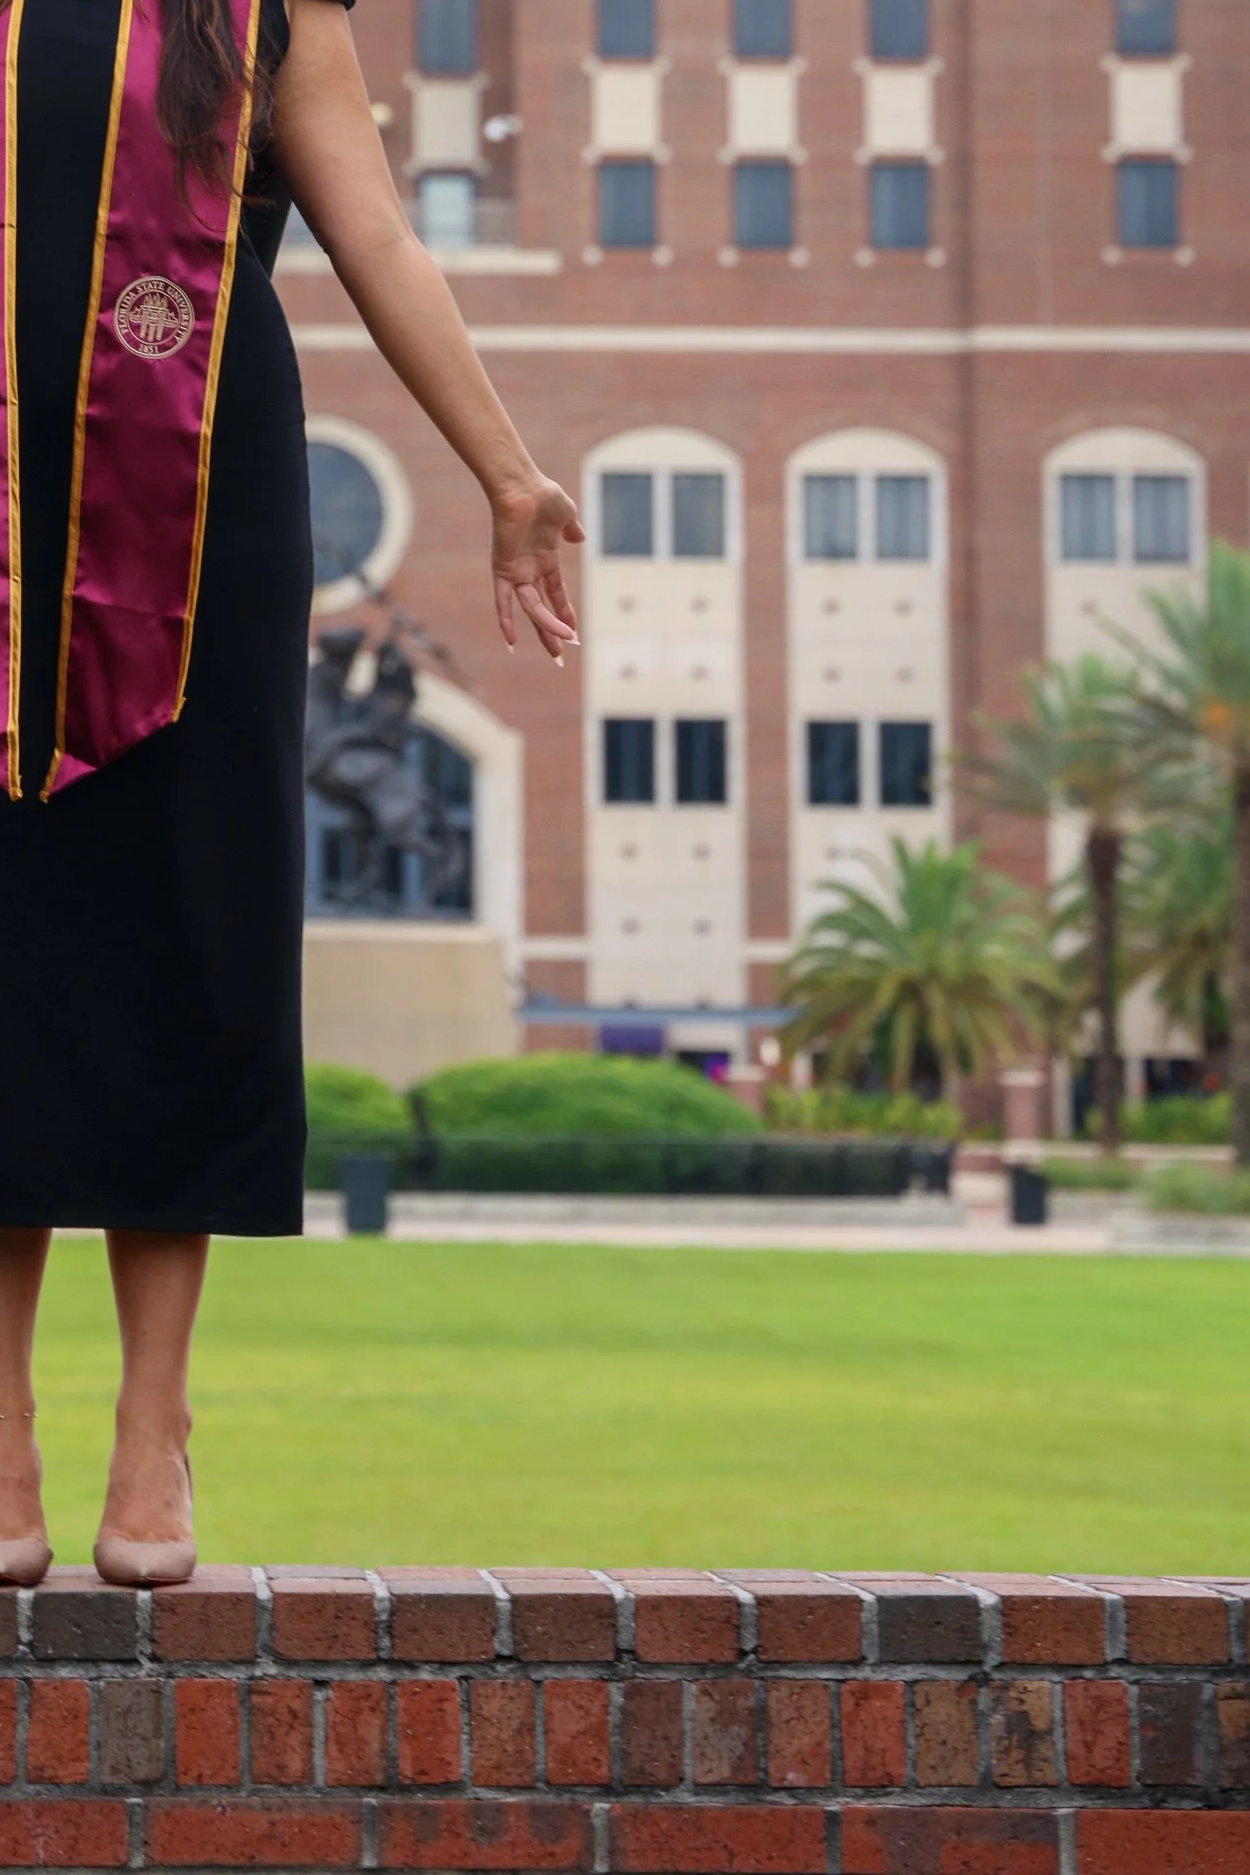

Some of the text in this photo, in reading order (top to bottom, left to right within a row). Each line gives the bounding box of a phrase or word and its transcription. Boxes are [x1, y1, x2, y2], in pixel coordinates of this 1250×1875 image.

[118, 281, 190, 343] FLORIDA STATE UNIVERSITY
[138, 343, 159, 354] 1851
